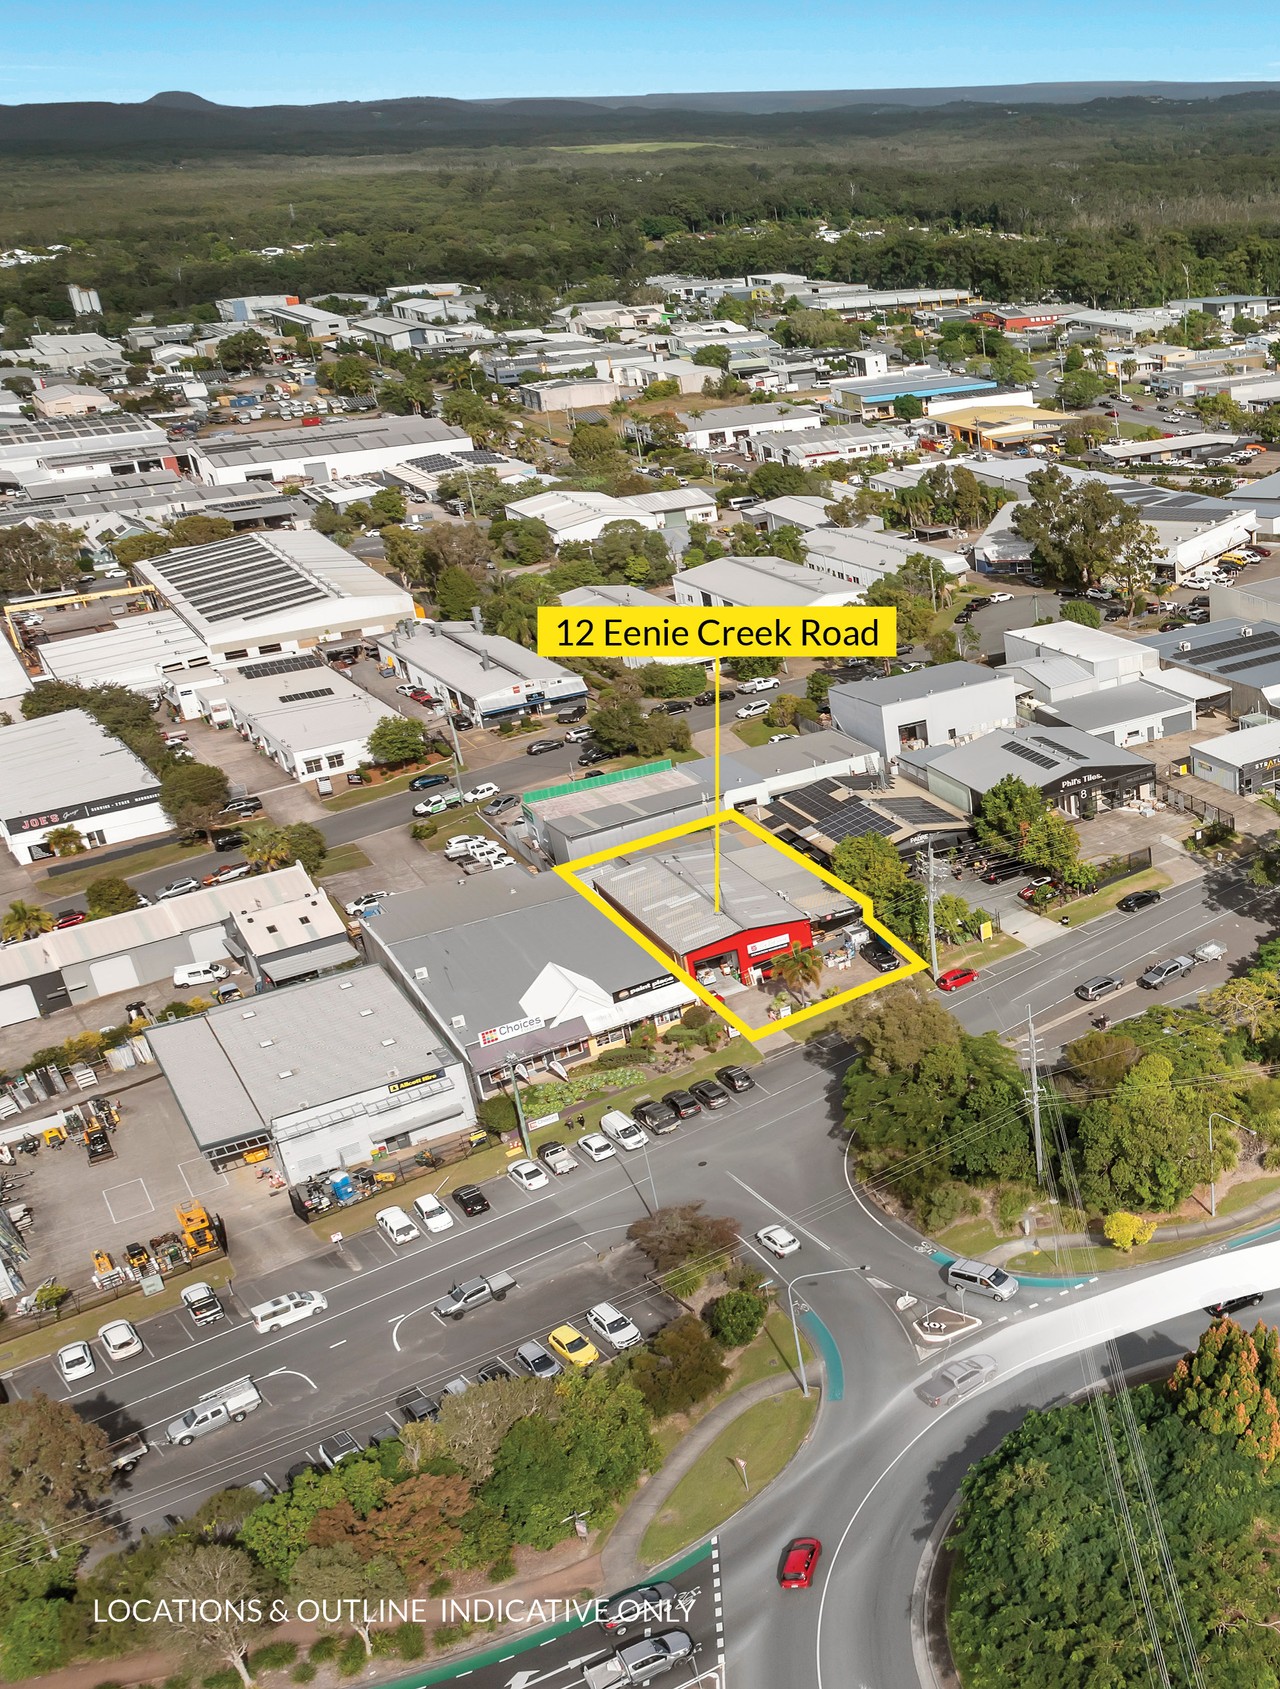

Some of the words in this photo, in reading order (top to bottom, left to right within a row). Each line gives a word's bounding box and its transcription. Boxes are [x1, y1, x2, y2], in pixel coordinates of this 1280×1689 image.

[1061, 778, 1082, 789] Phil's
[1080, 789, 1087, 799] 8
[21, 813, 60, 830] JOE'S
[629, 983, 652, 995] paint
[498, 1016, 542, 1036] Choices
